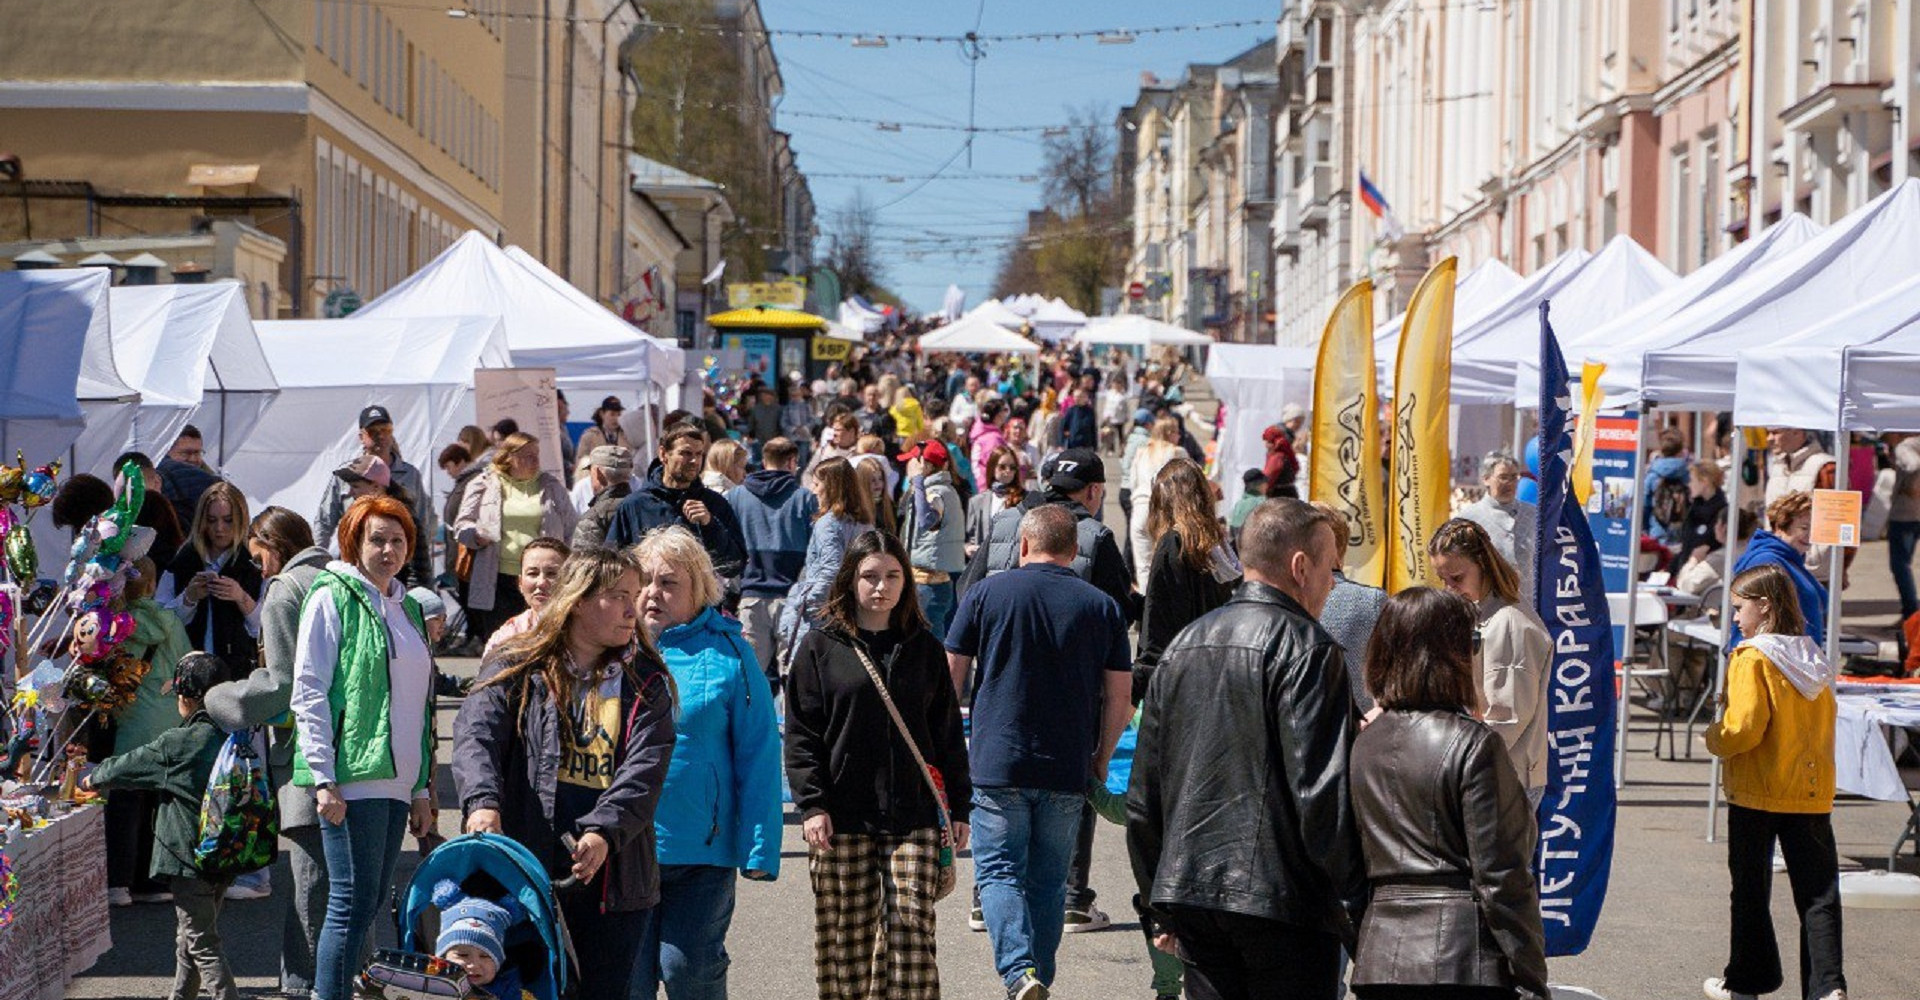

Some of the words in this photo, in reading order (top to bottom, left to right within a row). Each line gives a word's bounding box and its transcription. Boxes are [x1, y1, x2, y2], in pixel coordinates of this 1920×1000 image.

[1365, 521, 1376, 546] КЛУБ
[1418, 549, 1426, 580] КЛУБ
[1554, 526, 1594, 714] КОРАБЛЬ
[1539, 726, 1596, 927] ЛЕТУЧИЙ
